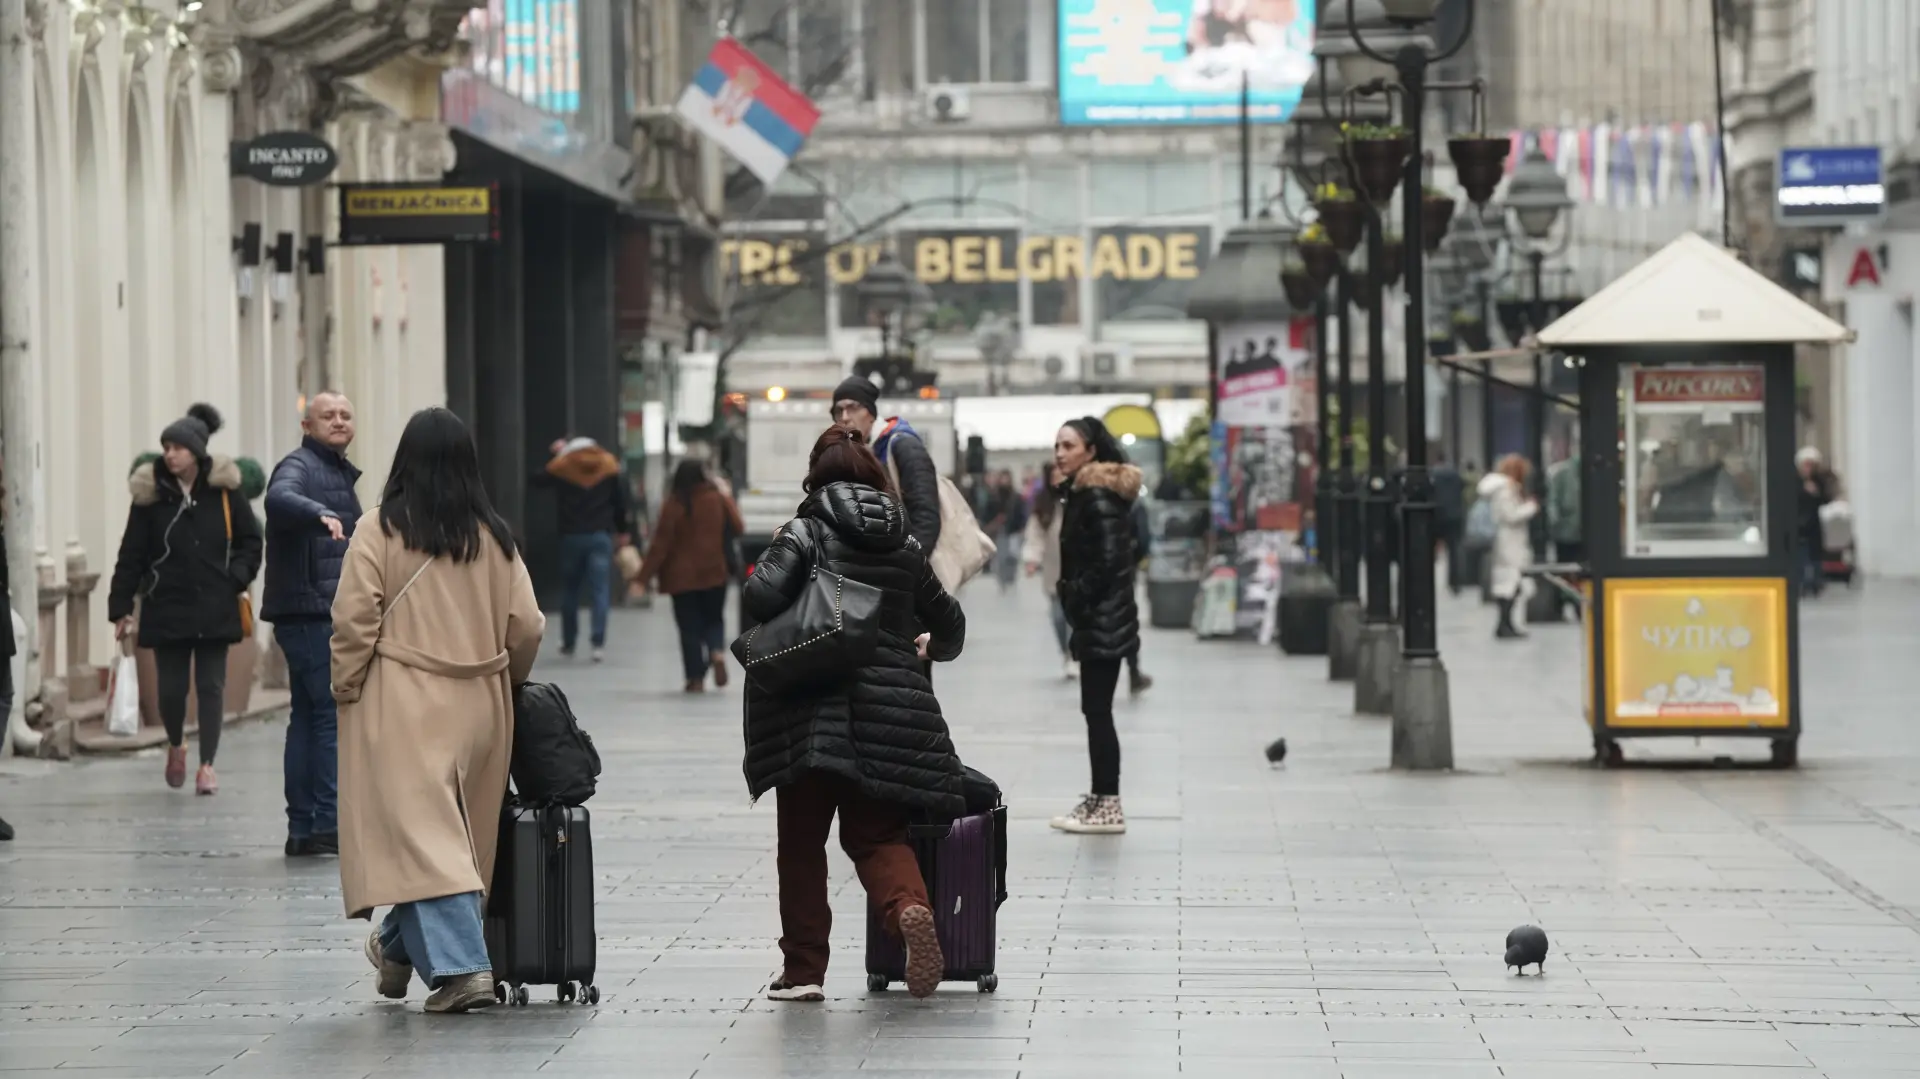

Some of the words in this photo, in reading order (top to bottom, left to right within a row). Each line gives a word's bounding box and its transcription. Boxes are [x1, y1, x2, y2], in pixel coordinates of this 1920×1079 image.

[249, 147, 328, 164] INCANTO
[352, 192, 482, 210] MENJAČNICA
[915, 233, 1199, 284] BELGRADE
[1641, 375, 1755, 396] POPCORN
